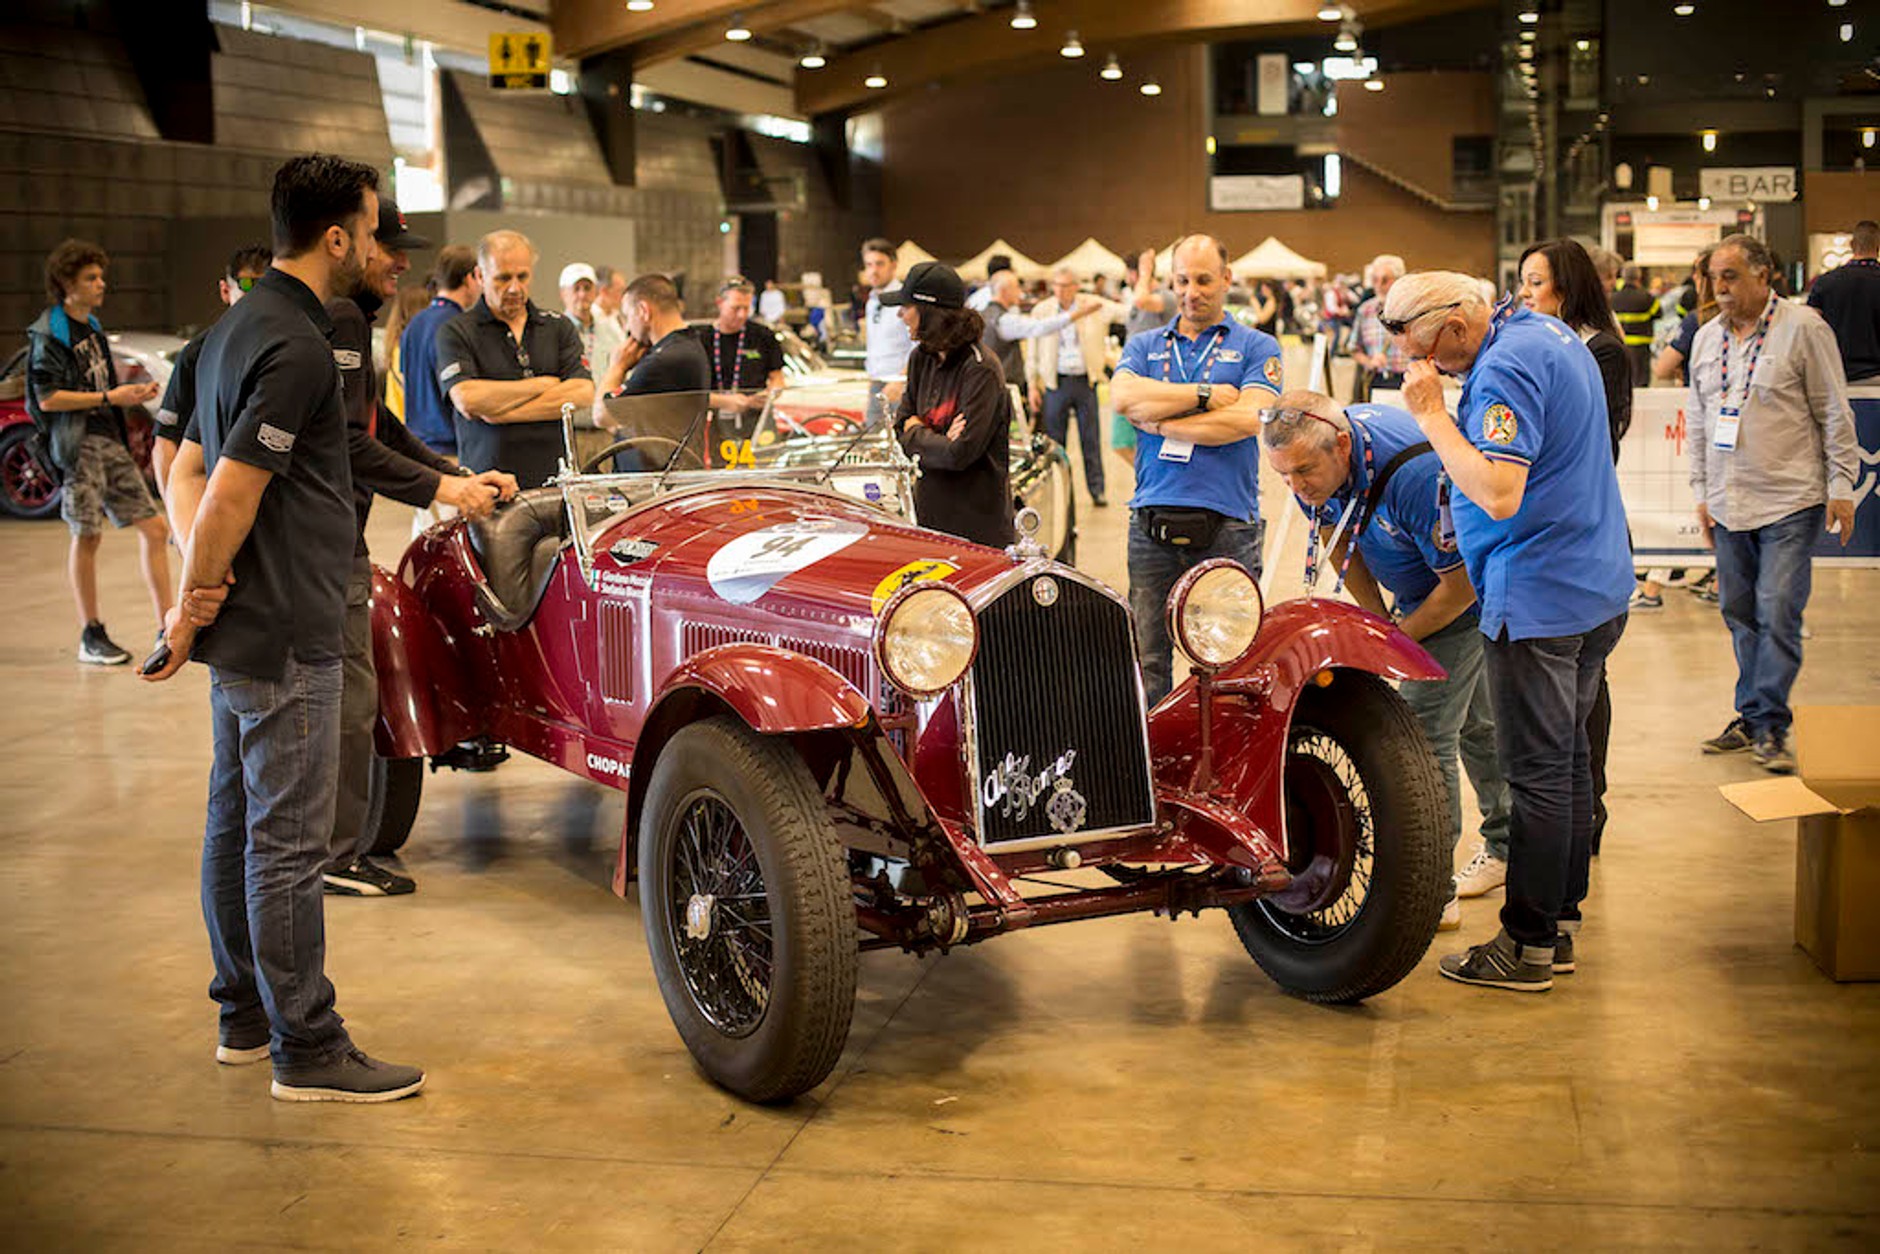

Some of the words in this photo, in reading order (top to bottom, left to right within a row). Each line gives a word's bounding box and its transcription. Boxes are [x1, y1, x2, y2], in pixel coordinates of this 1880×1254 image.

[1729, 174, 1792, 195] BAR
[720, 439, 756, 471] 94
[750, 535, 819, 559] 94
